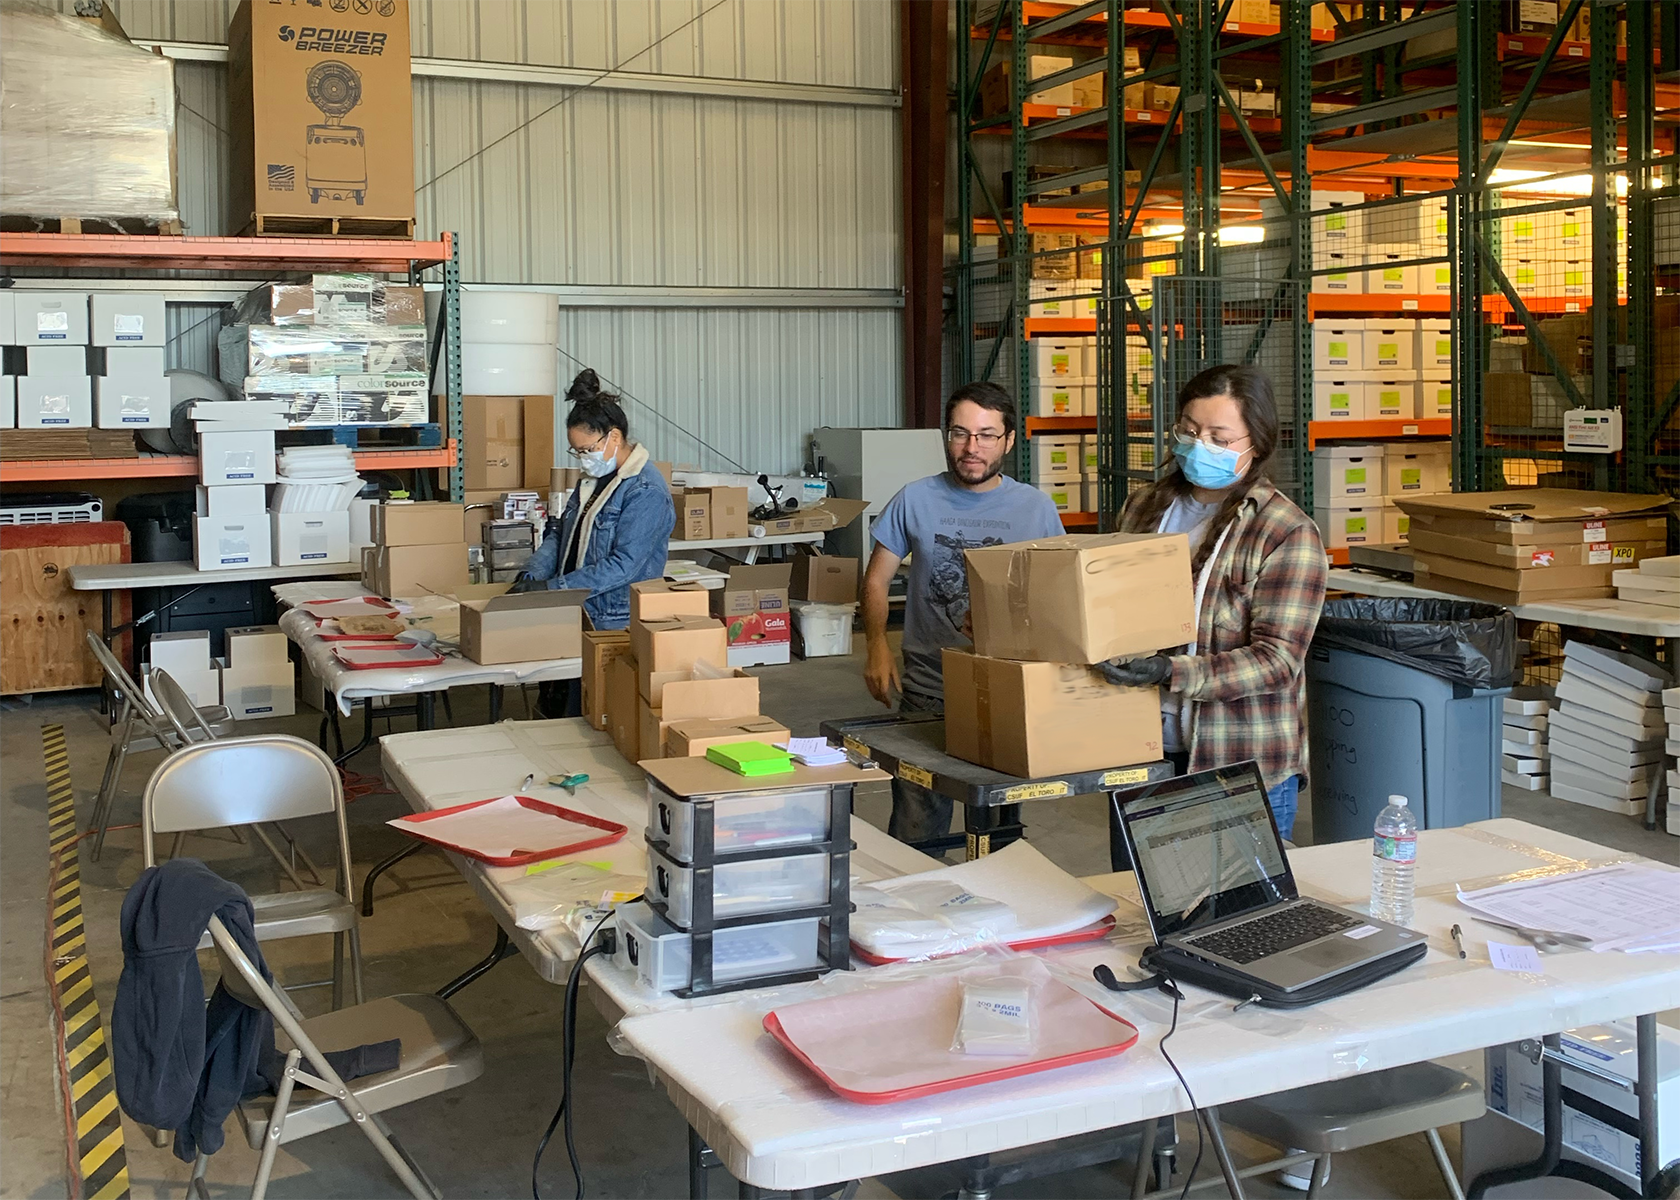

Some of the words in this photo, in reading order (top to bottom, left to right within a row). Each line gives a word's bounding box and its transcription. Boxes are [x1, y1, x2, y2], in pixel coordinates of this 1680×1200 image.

[298, 27, 388, 46] POWER
[295, 41, 384, 56] BREEZER
[357, 377, 426, 388] colorsource
[1616, 548, 1632, 558] XPO
[764, 618, 785, 628] Gala
[1145, 741, 1159, 751] 92
[994, 1003, 1022, 1012] BAGS
[1491, 1066, 1504, 1098] Inc.
